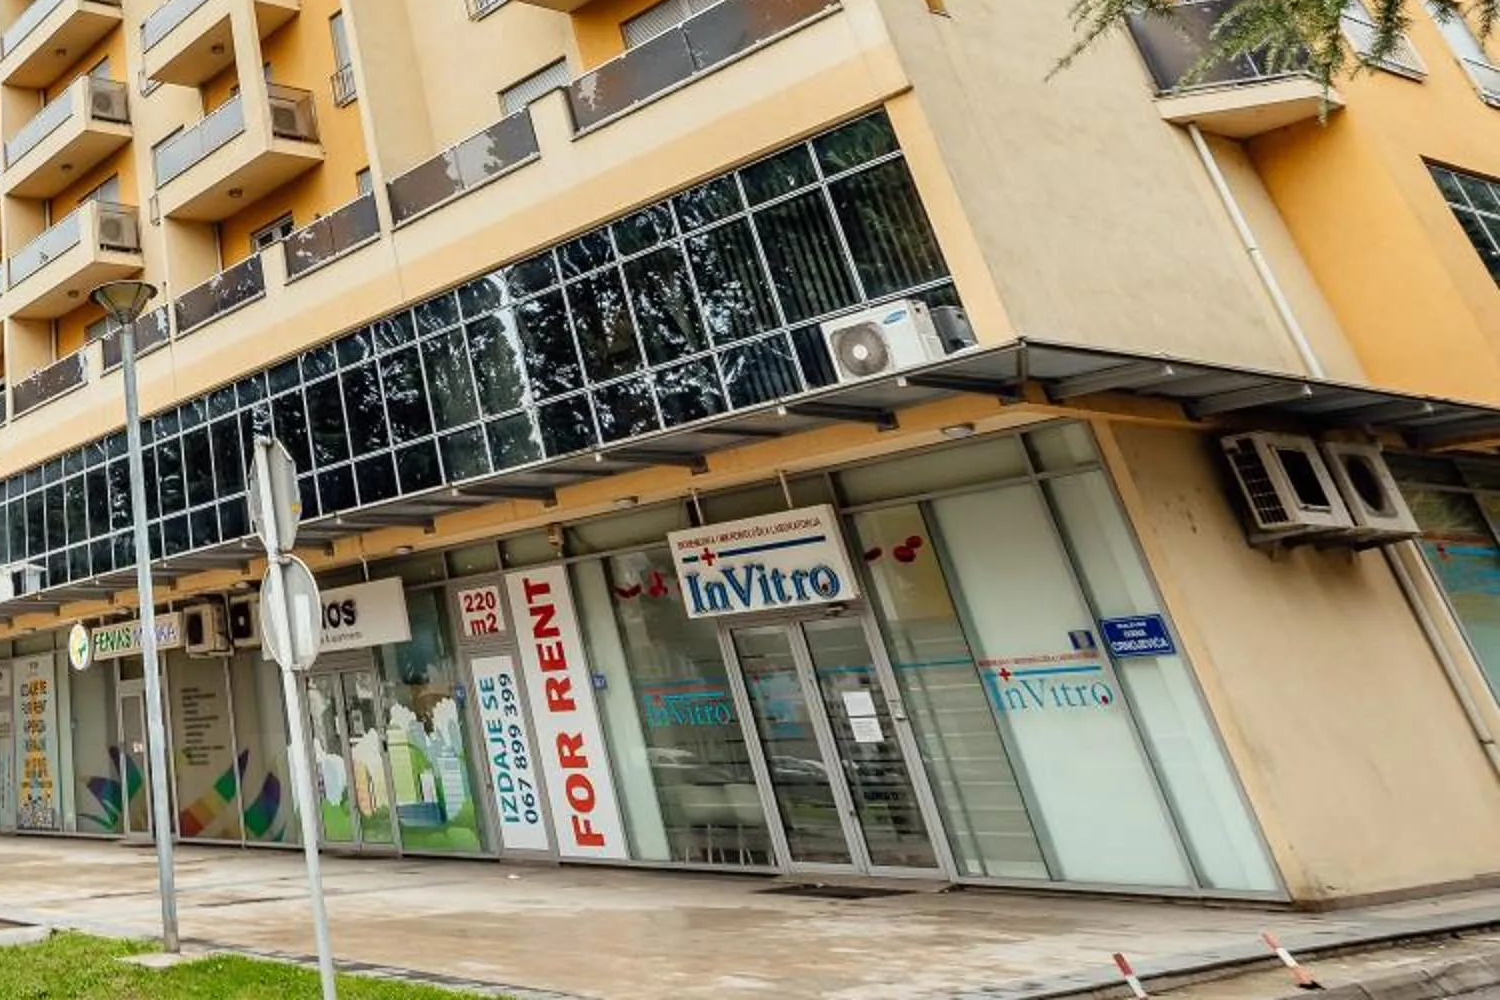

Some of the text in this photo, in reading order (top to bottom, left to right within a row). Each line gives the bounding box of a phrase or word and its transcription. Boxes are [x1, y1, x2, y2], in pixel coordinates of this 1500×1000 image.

[463, 591, 497, 613] 220
[685, 562, 841, 614] InVitro
[469, 613, 500, 635] m2
[522, 577, 606, 847] FOR RENT
[984, 670, 1115, 713] InVitro
[479, 676, 518, 824] IZDAJE SE
[498, 673, 540, 826] 067 899 399
